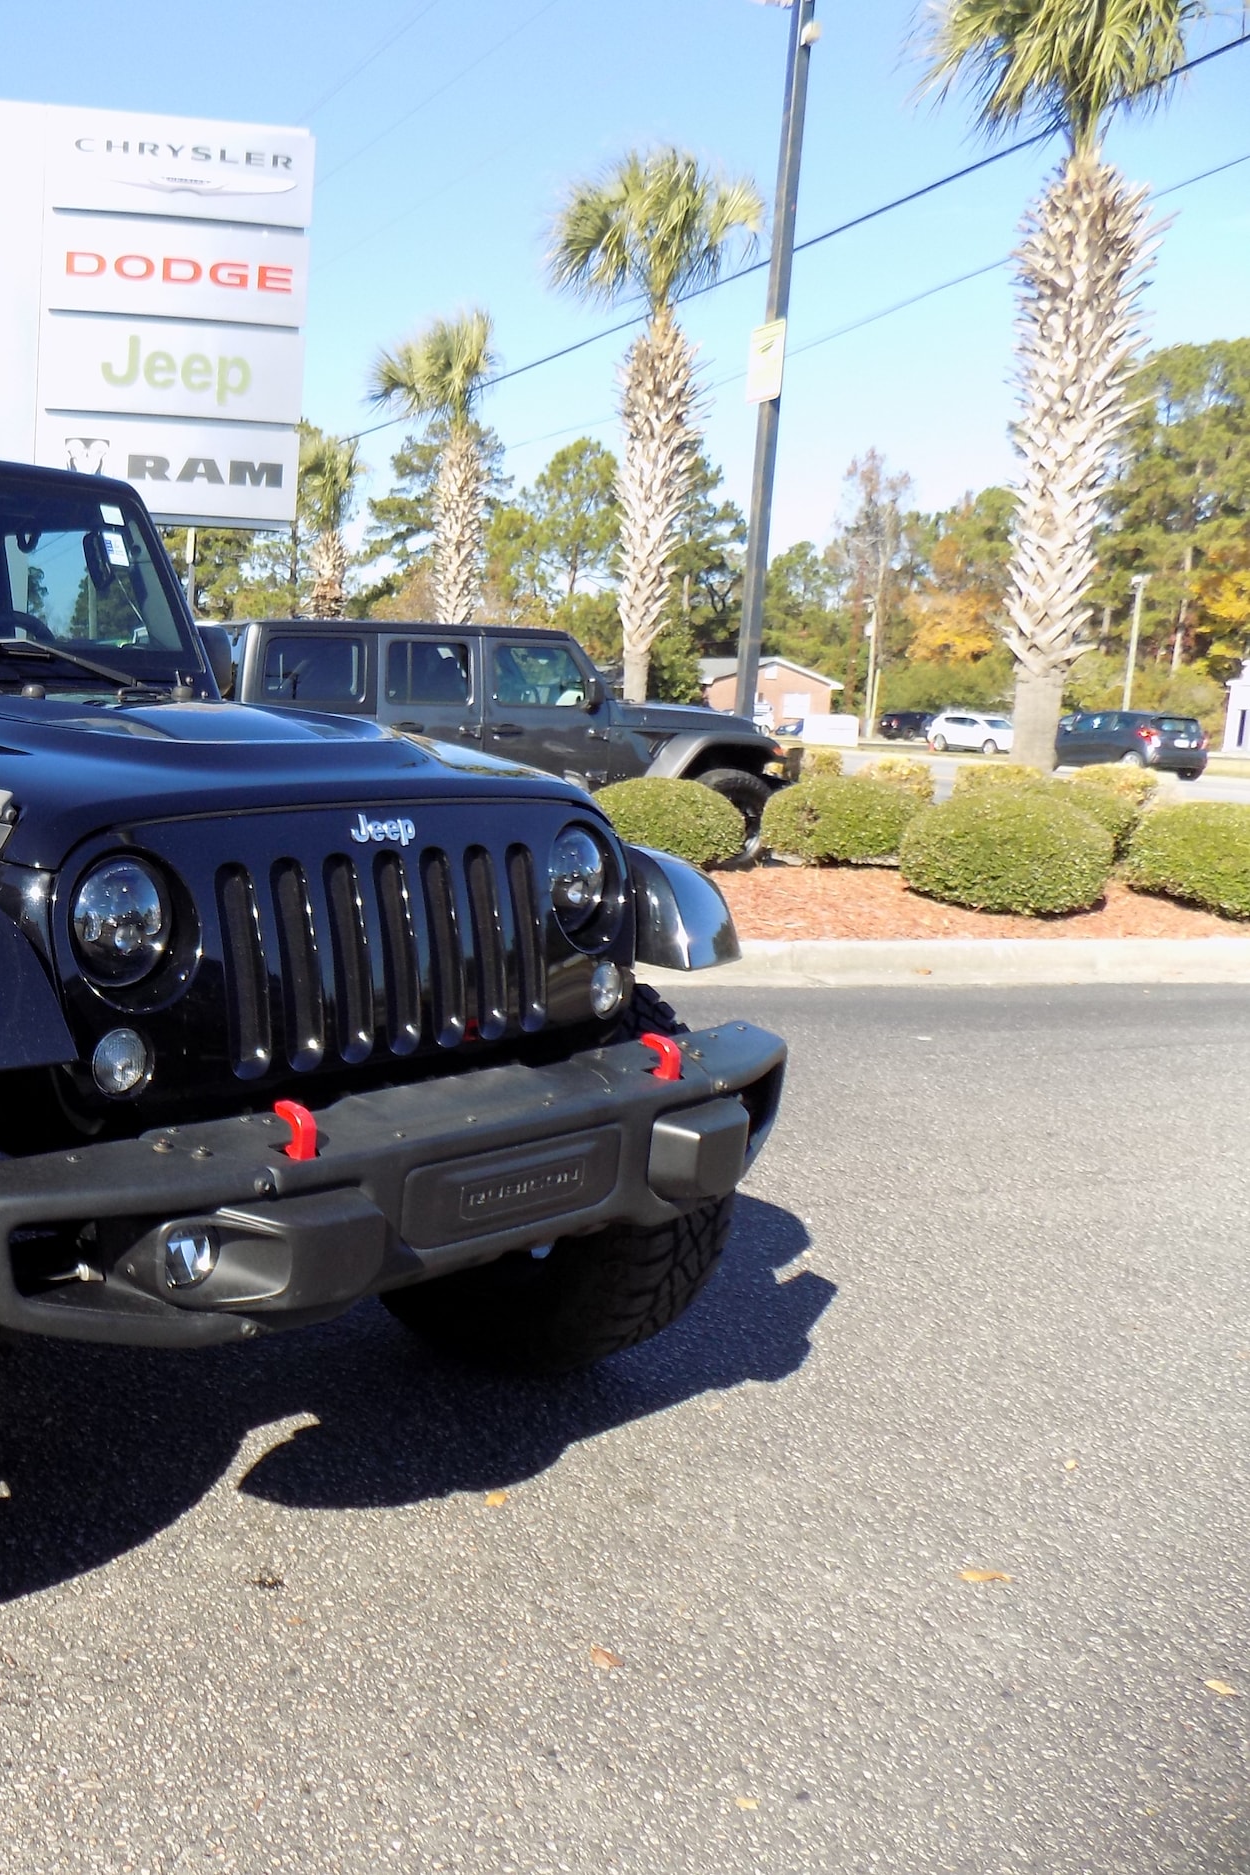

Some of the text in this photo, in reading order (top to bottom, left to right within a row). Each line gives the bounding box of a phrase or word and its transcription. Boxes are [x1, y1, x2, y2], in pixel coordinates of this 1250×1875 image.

[74, 137, 294, 171] CHRYSLER
[65, 250, 294, 295] DODGE
[100, 334, 252, 407] Jeep
[127, 453, 284, 489] RAM
[351, 813, 416, 847] Jeep
